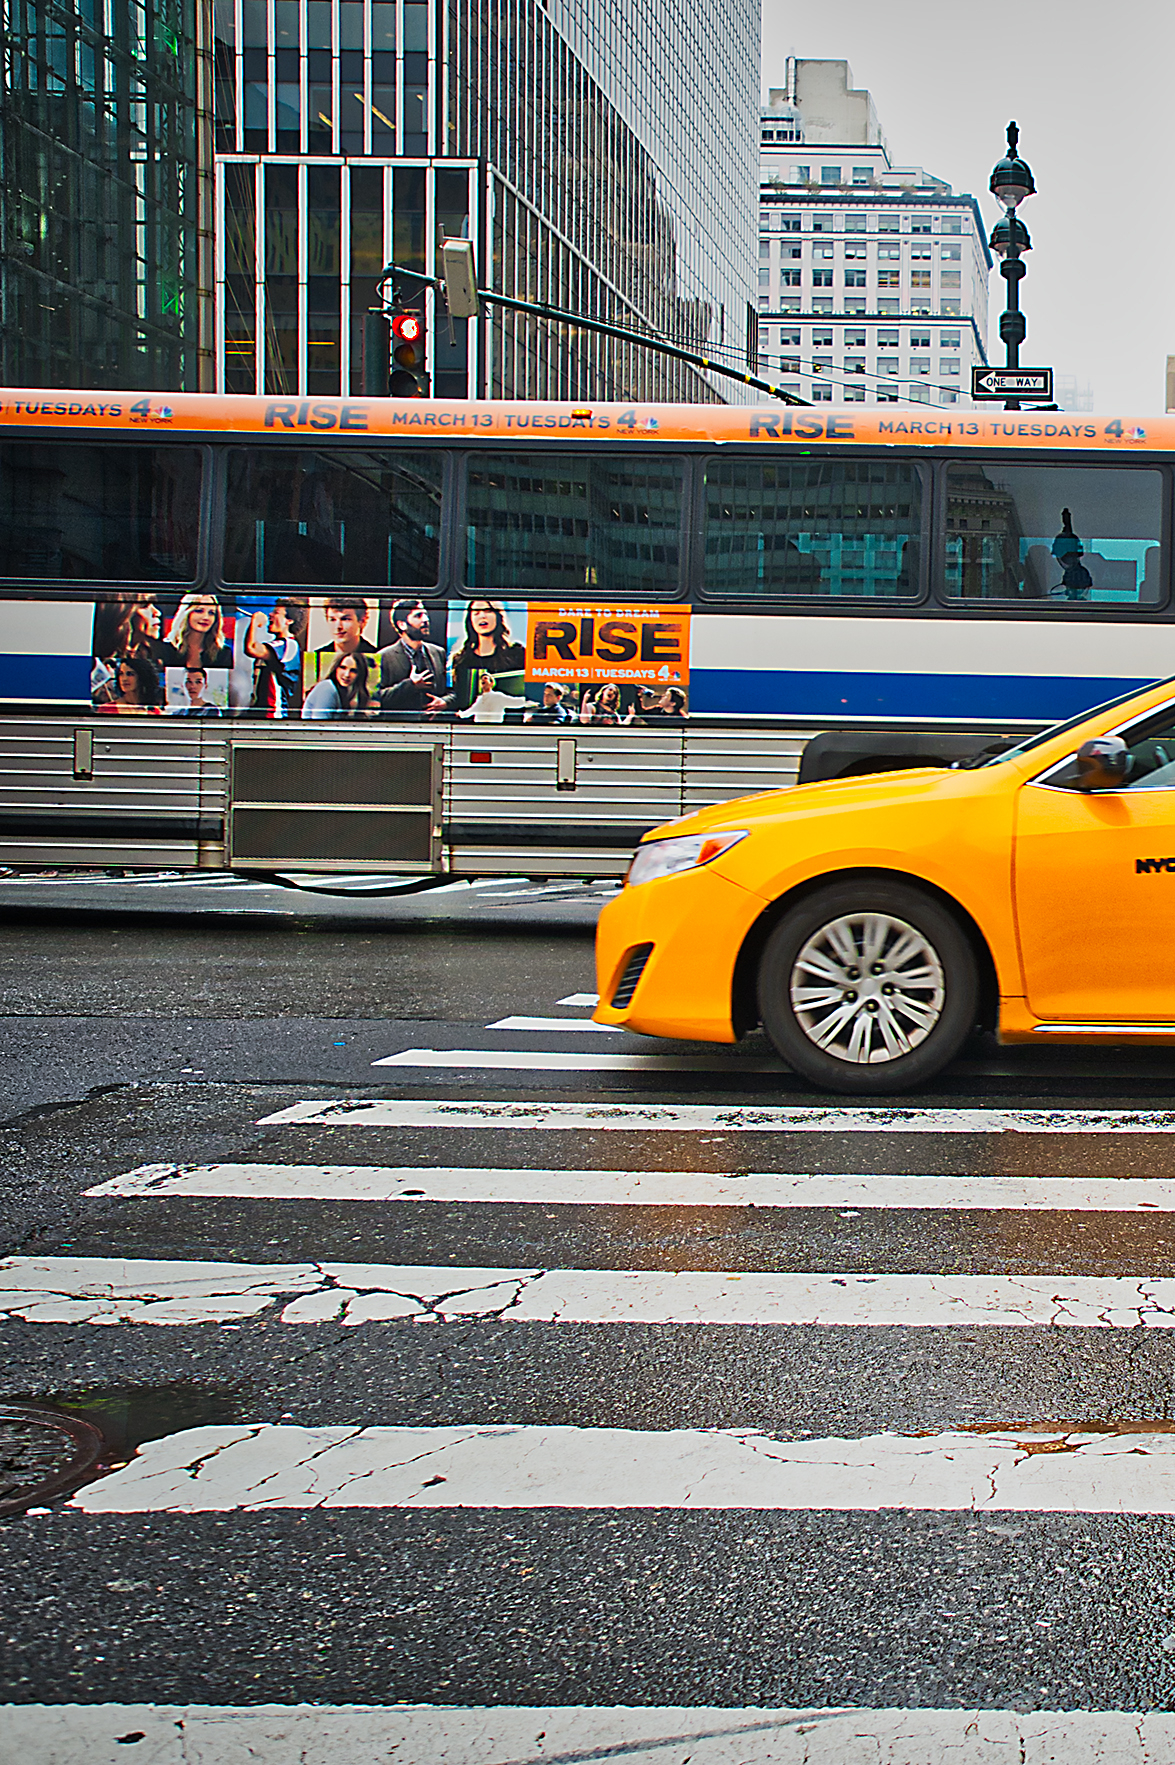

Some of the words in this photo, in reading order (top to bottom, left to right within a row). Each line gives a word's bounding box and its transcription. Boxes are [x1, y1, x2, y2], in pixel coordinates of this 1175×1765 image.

[986, 377, 1006, 387] ONE
[1016, 377, 1038, 387] WAY
[15, 401, 122, 417] TUESDAYS
[129, 399, 151, 418] 4
[264, 402, 369, 430] RISE
[392, 412, 464, 427] MARCH
[472, 414, 493, 428] 13
[504, 414, 611, 429] TUESDAYS
[617, 409, 636, 429] 4
[749, 412, 855, 439] RISE
[878, 421, 951, 435] MARCH
[958, 422, 979, 436] 13
[990, 422, 1096, 438] TUESDAYS
[1104, 419, 1124, 438] 4
[558, 608, 592, 617] DARE
[596, 608, 612, 618] TO
[616, 609, 660, 618] DREAM
[534, 618, 682, 662] RISE
[532, 668, 574, 677] MARCH
[576, 668, 589, 678] 13
[595, 668, 656, 678] TUESDAYS
[658, 665, 670, 679] 4
